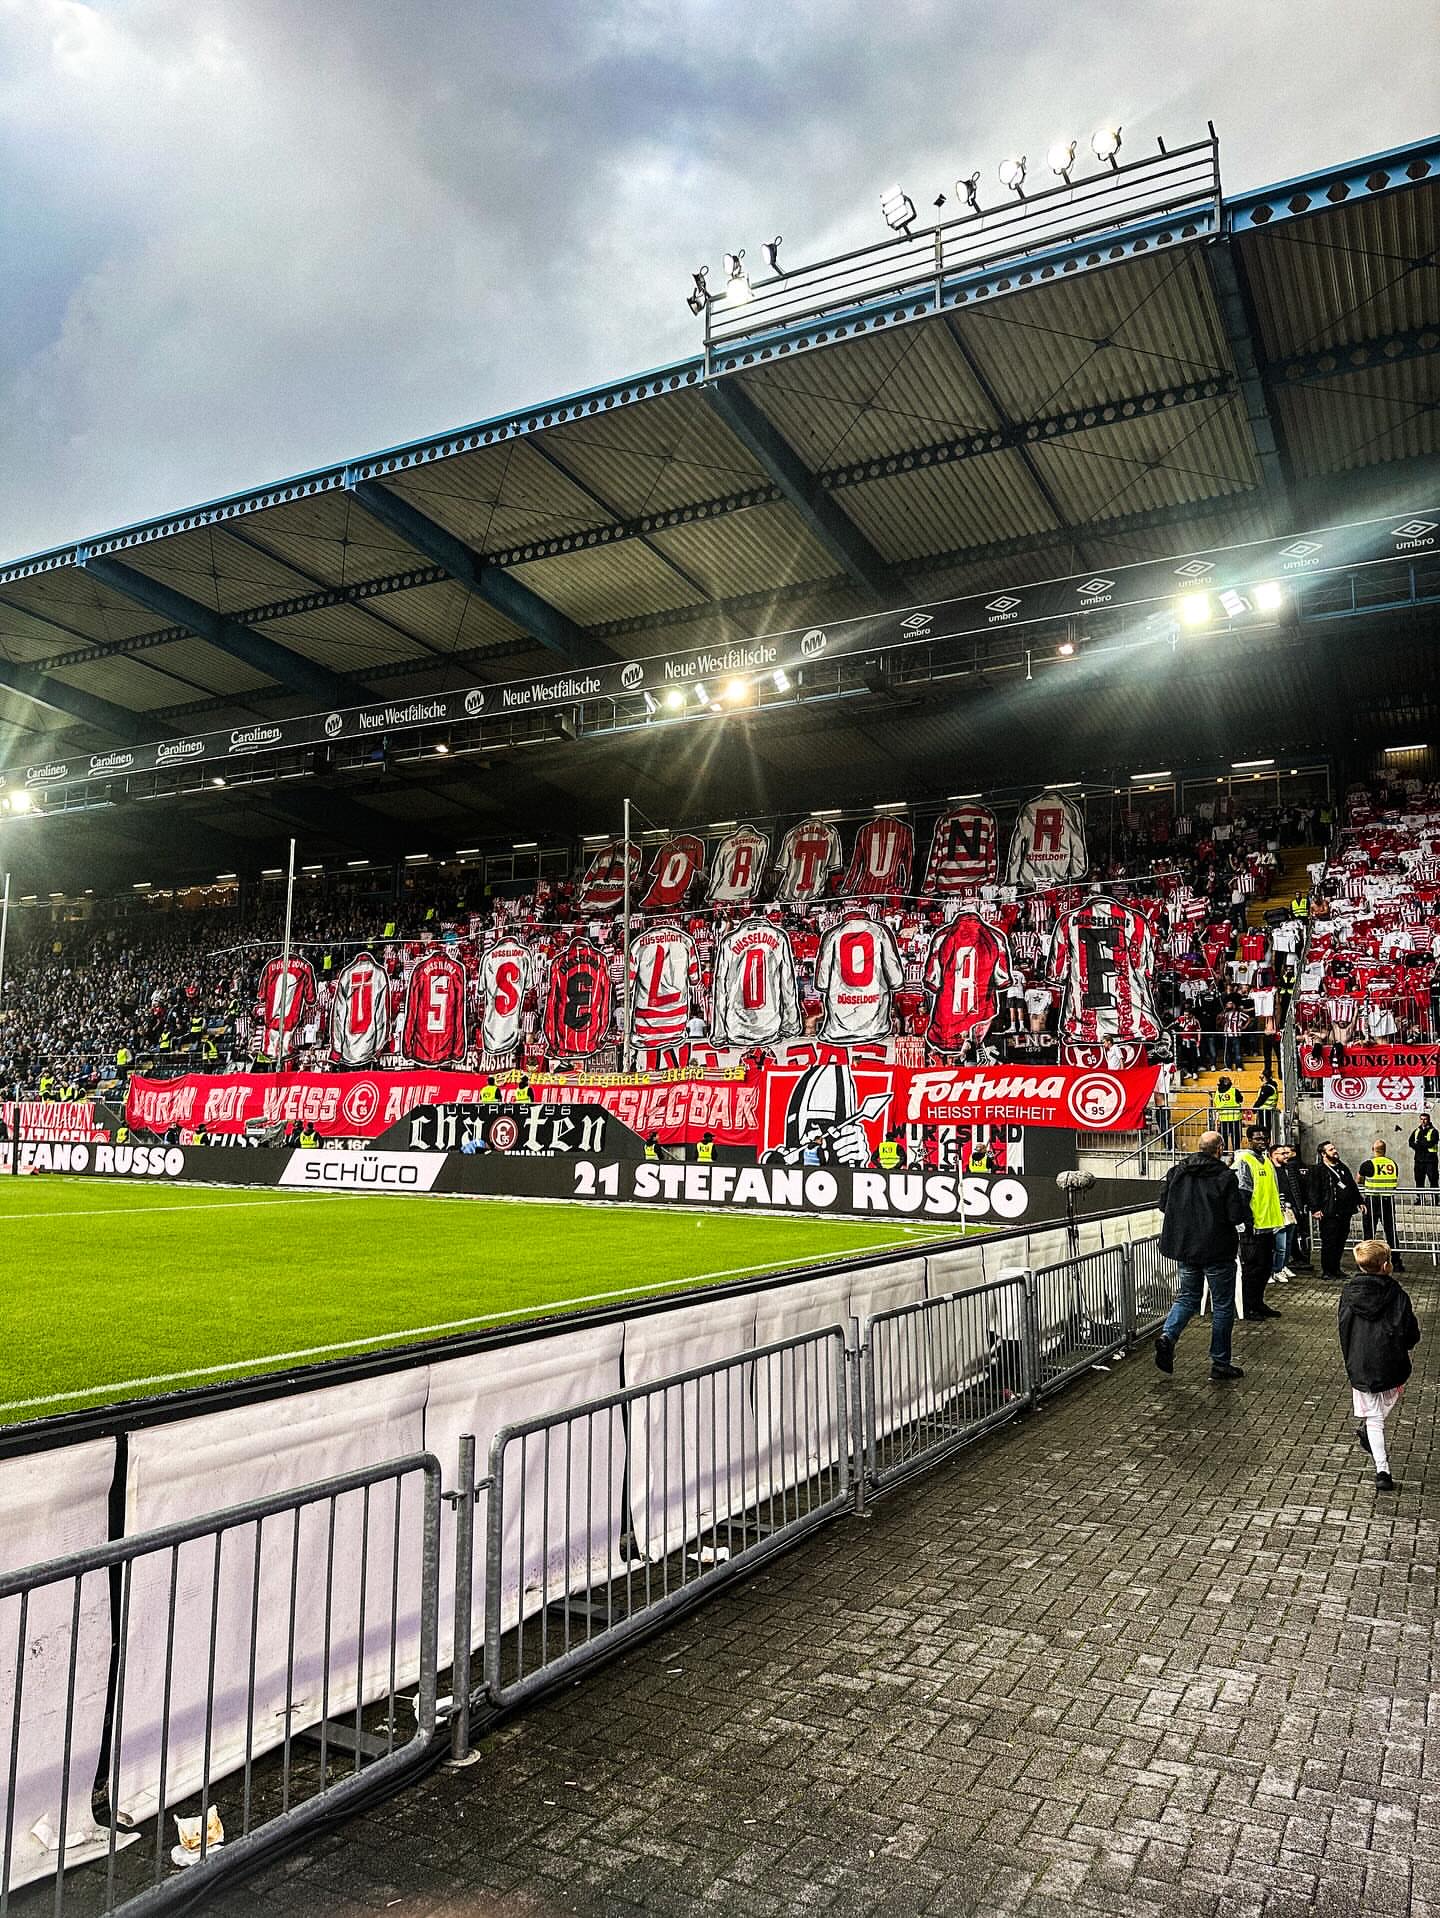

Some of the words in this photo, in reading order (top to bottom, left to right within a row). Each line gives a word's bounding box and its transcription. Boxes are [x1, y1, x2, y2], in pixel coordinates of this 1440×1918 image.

[1396, 536, 1434, 550] umbro
[1283, 556, 1319, 570] umbro
[1178, 576, 1212, 588] umbro
[1080, 593, 1112, 606] umbro
[988, 612, 1018, 623] umbro
[903, 628, 931, 639] umbro
[664, 660, 696, 679] Neue
[698, 645, 777, 673] Westfälische
[502, 688, 531, 707] Neue
[531, 676, 600, 703] Westfälische
[359, 711, 385, 729] Neue
[385, 701, 446, 724] Westfälische
[231, 727, 281, 744] Carolinen
[157, 740, 203, 756] Carolinen
[90, 752, 132, 769] Carolinen
[26, 763, 67, 780] Carolinen
[948, 819, 983, 860] N
[870, 831, 897, 877] U
[794, 840, 829, 891] T
[732, 931, 779, 955] DÜSSELDORF
[648, 944, 681, 1007] L
[495, 961, 520, 1017] S
[837, 992, 880, 1005] DÜSSELDORF
[563, 971, 593, 1029] E
[1329, 1053, 1389, 1067] OUNG
[1393, 1053, 1440, 1067] BOYS
[133, 1086, 198, 1124] VORAN
[204, 1085, 253, 1122] ROT
[263, 1085, 341, 1122] WEISS
[909, 1070, 1066, 1121] Fortuna
[1218, 1094, 1231, 1103] K9
[927, 1105, 983, 1119] HEISST
[986, 1105, 1056, 1121] FREIHEIT
[95, 1145, 185, 1176] RUSSO
[305, 1156, 418, 1184] SCHÜCO
[1376, 1164, 1394, 1176] K9
[574, 1160, 620, 1195] 21
[633, 1162, 838, 1208] STEFANO
[852, 1171, 1029, 1219] RUSSO
